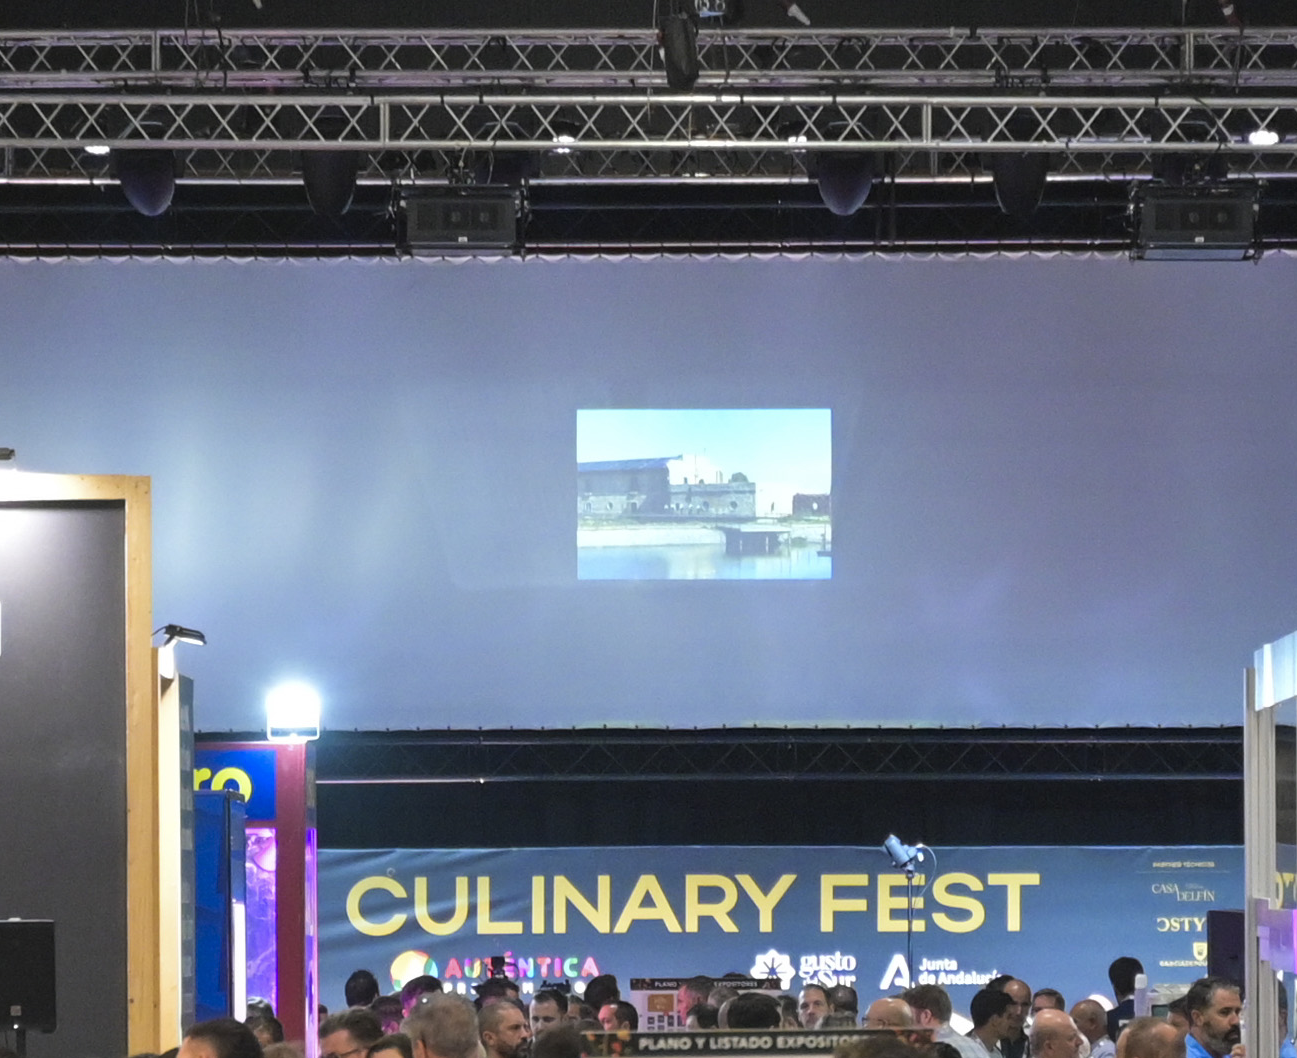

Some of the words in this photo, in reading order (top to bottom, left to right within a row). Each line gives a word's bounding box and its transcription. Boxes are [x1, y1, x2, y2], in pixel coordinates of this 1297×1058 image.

[1152, 883, 1179, 894] CASA
[345, 874, 797, 937] CULINARY
[820, 872, 1041, 934] FEST
[798, 951, 857, 977] gusto
[919, 958, 958, 972] Junta
[818, 971, 857, 988] Sur
[918, 972, 937, 985] de
[638, 1037, 693, 1051] PLANO
[696, 1037, 707, 1051] Y
[709, 1036, 773, 1051] LISTADO
